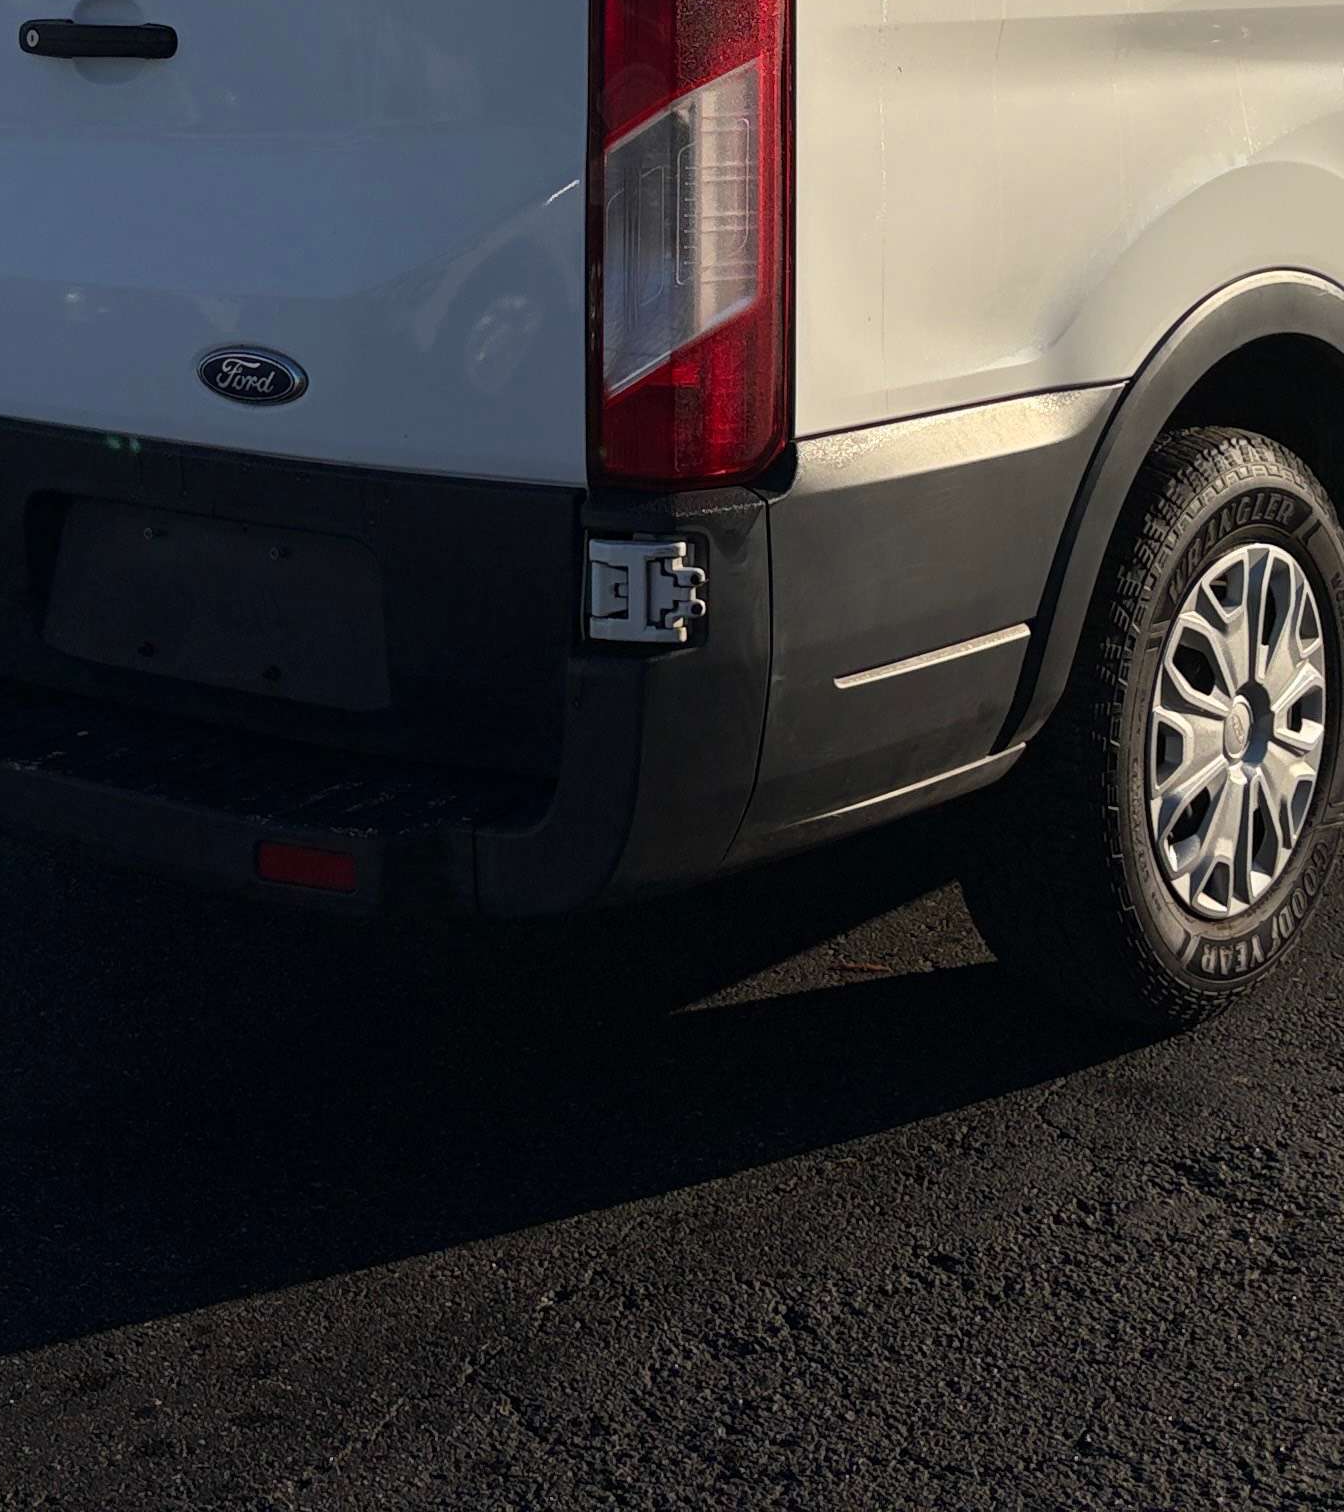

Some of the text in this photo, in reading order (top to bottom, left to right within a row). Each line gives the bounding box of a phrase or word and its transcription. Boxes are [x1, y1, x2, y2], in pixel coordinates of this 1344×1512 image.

[216, 358, 278, 393] Ford
[1169, 492, 1298, 605] WRANGLER
[1200, 841, 1329, 976] GOODYEAR
